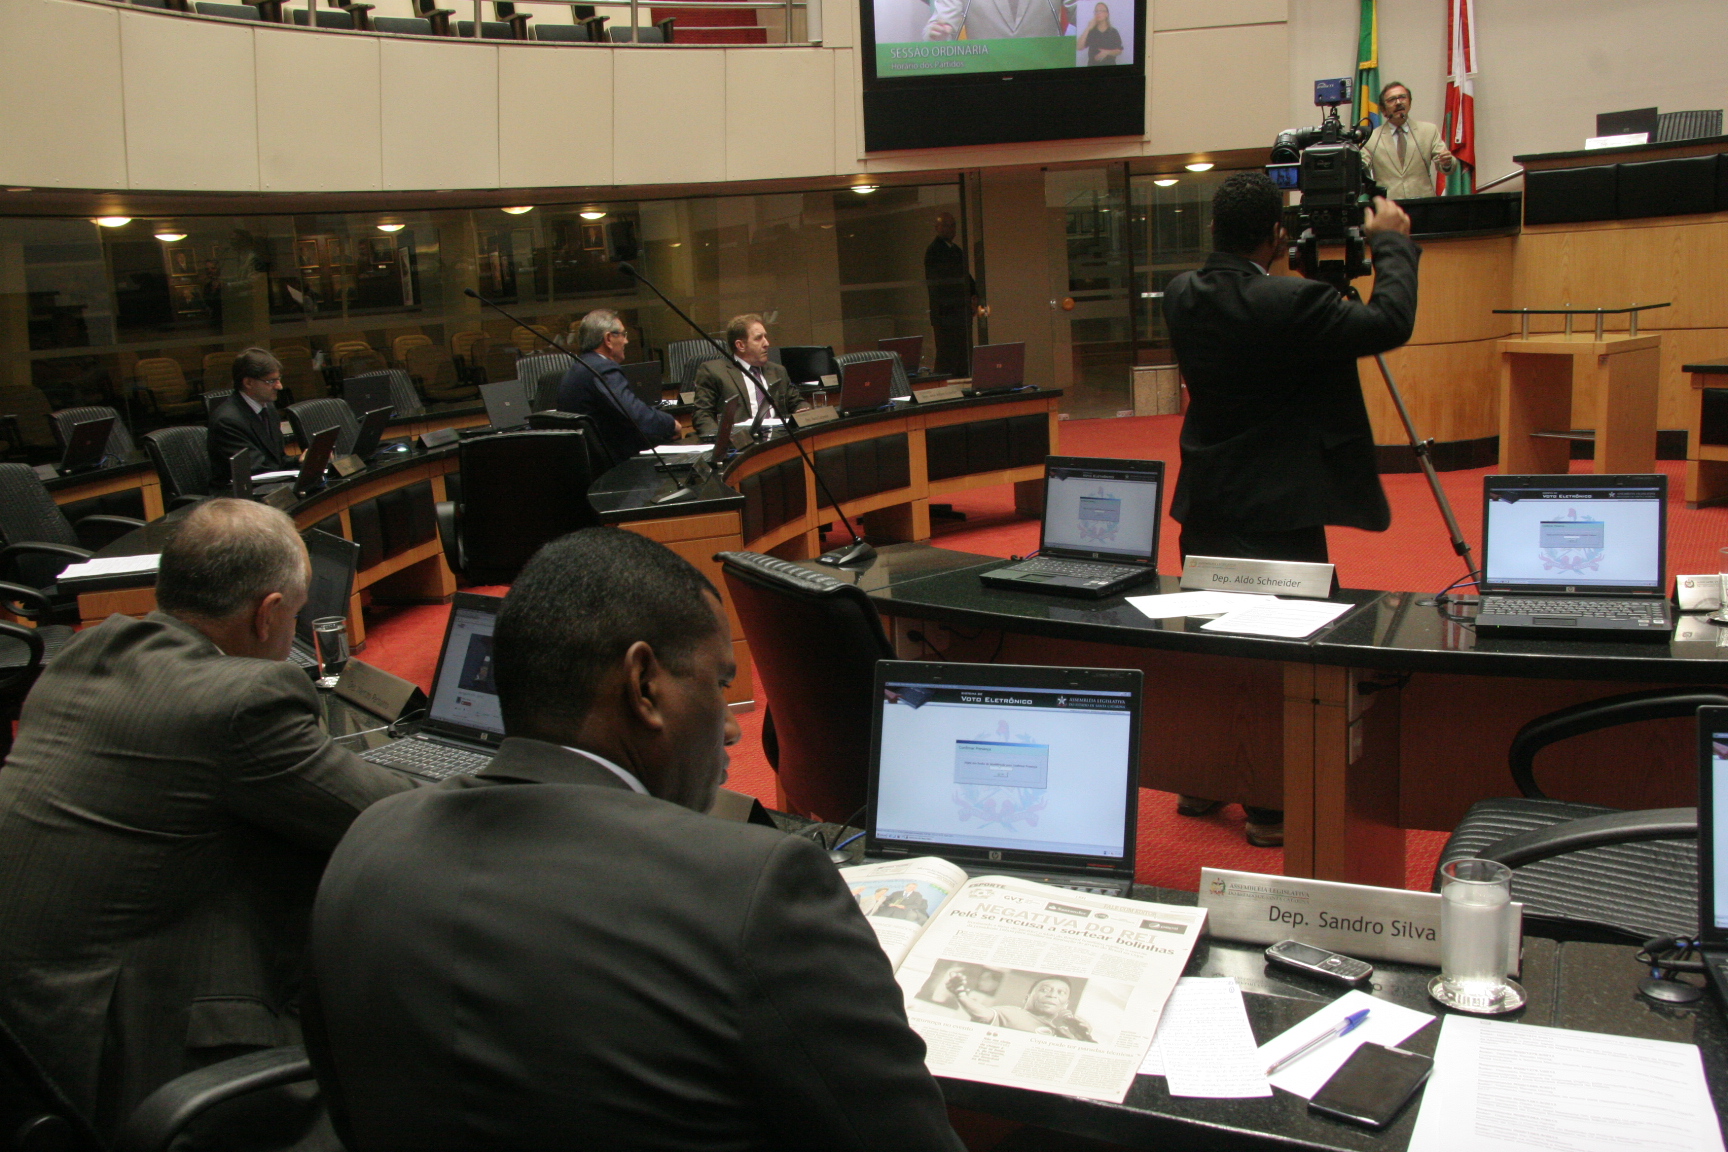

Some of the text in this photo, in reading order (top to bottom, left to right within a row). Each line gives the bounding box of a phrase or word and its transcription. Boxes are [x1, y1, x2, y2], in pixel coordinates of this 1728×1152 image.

[890, 44, 989, 59] SESSÃO ORDINÁRIA
[920, 61, 933, 69] dos
[934, 60, 965, 68] Partidos
[1212, 573, 1302, 588] Dep. Aldo Schneider
[1268, 887, 1311, 898] LEGISLATIVA
[975, 902, 1078, 929] NEGATIVA
[1084, 922, 1115, 935] DO
[1120, 929, 1157, 944] REI
[1268, 905, 1437, 942] Dep. Sandro Silva
[950, 909, 978, 918] Pelé
[980, 913, 996, 921] se
[999, 917, 1044, 929] recusa
[1061, 928, 1112, 941] sortear
[1116, 937, 1175, 955] bolinhas
[909, 1016, 942, 1026] egurança
